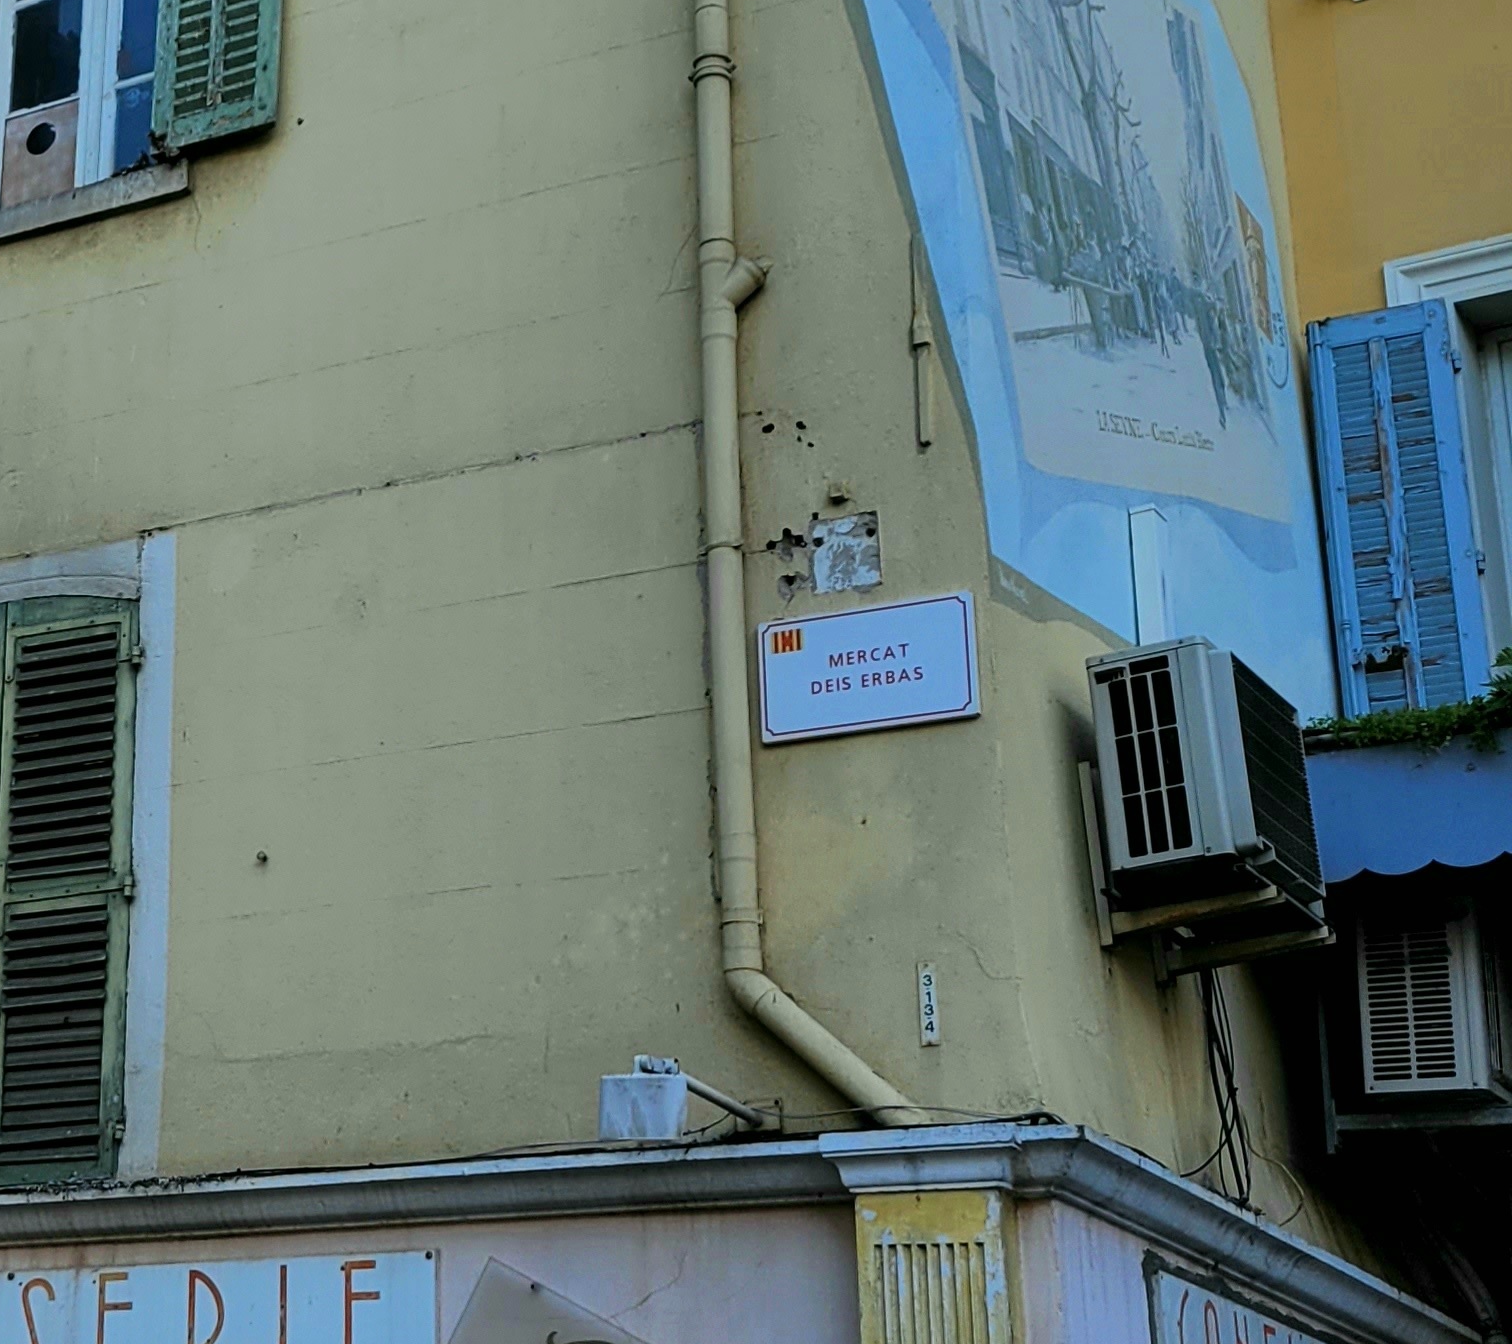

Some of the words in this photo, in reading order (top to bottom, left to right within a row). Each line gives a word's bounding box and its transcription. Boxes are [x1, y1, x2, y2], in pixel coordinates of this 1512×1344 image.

[828, 642, 911, 668] MERCAT
[810, 677, 852, 695] DEIS
[861, 666, 924, 688] ERBAS
